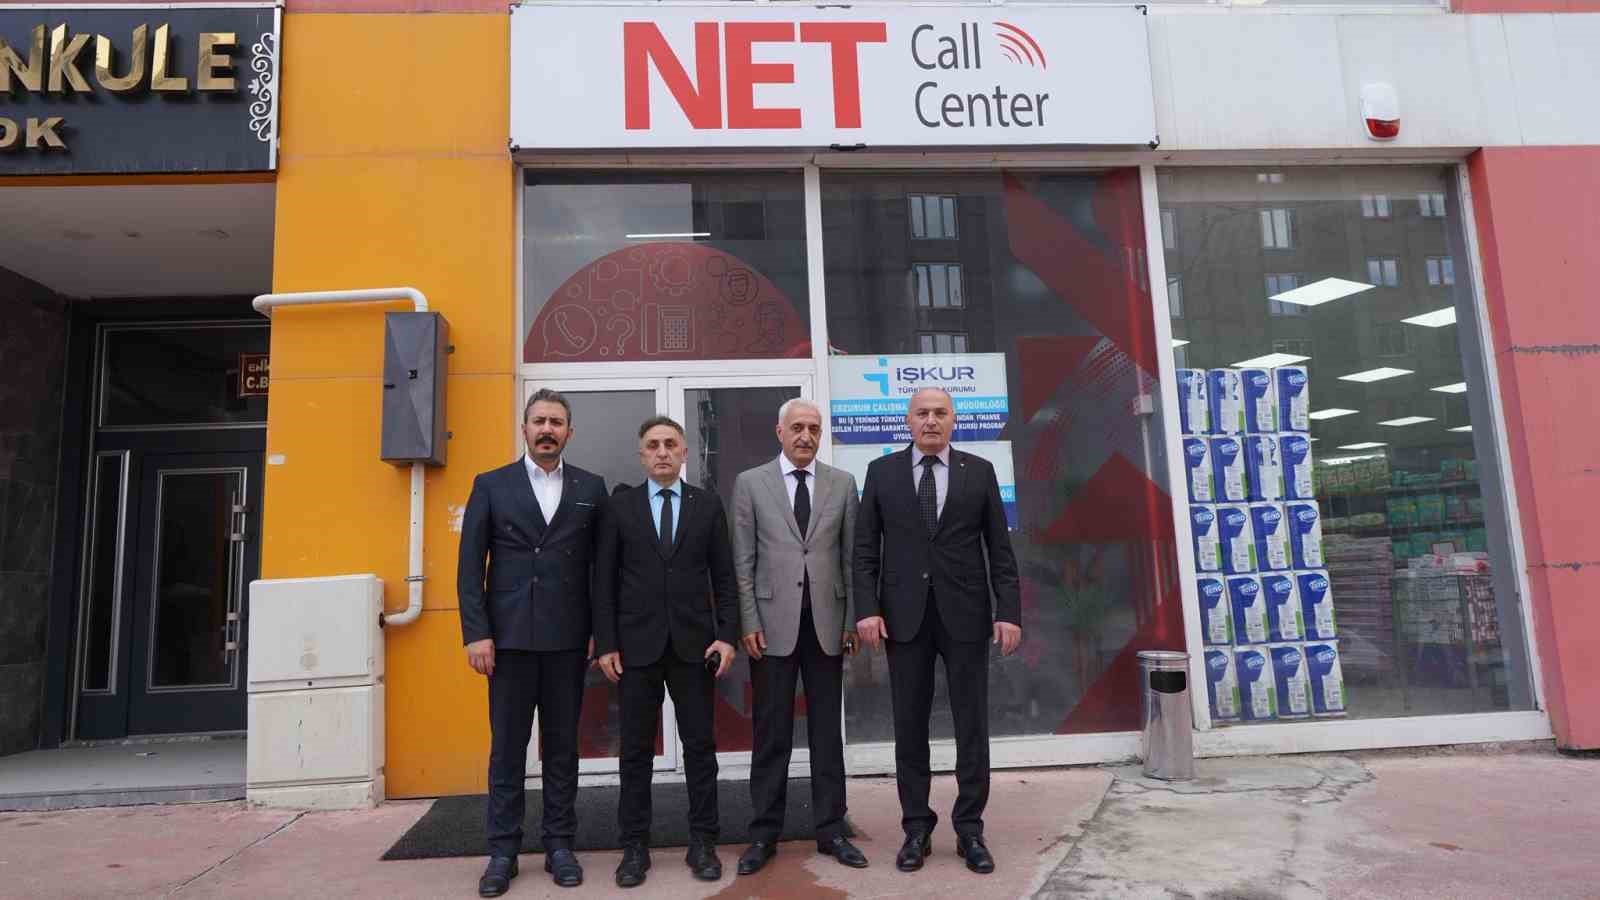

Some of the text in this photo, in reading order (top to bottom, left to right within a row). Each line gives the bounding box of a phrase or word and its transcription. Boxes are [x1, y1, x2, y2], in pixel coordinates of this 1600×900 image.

[911, 22, 982, 70] Call
[623, 22, 887, 130] NET
[914, 81, 1049, 128] Center
